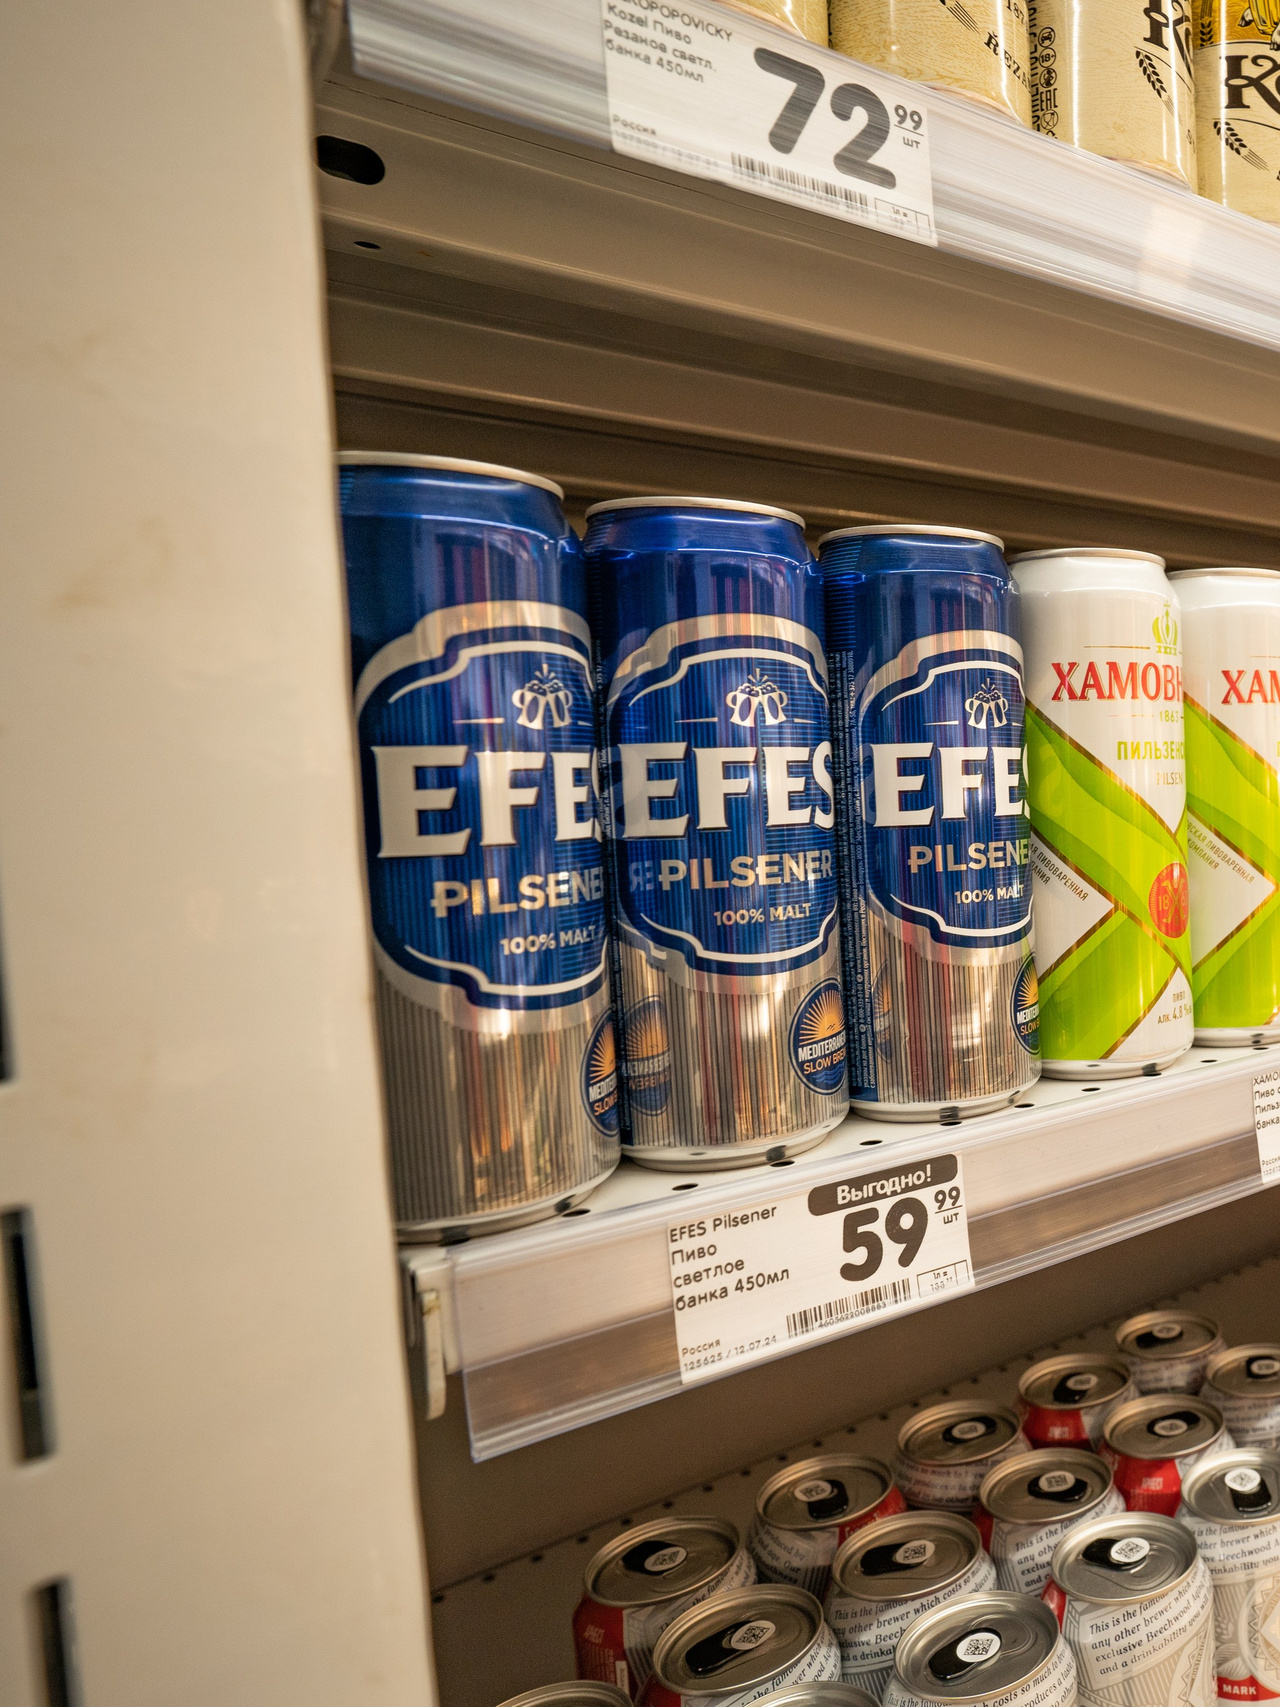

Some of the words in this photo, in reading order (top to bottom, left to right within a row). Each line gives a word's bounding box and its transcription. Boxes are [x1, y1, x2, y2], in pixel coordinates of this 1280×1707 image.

[604, 20, 667, 53] Резаное
[607, 2, 648, 28] Kozel
[653, 20, 691, 45] Пиво
[606, 38, 651, 65] банка
[656, 56, 704, 83] 450мл
[613, 114, 656, 136] Россия
[754, 47, 896, 190] 72
[894, 104, 923, 131] 99
[902, 136, 921, 150] шт
[618, 741, 835, 839] EFES
[870, 742, 1030, 828] EFE
[371, 745, 601, 858] EFE
[659, 849, 832, 891] PILSENER
[1037, 851, 1089, 901] ПИВОВАРЕННАЯ
[955, 889, 993, 904] 100%
[997, 885, 1024, 901] MALT
[714, 907, 765, 926] 100%
[770, 903, 811, 922] MALT
[501, 933, 557, 955] 100%
[560, 925, 596, 948] MALT
[803, 1057, 831, 1074] SLOW
[1255, 1087, 1275, 1100] Пиво
[1256, 1115, 1280, 1130] банка
[836, 1164, 932, 1205] Выгодно!
[934, 1185, 961, 1209] 99
[670, 1222, 707, 1243] EFES
[713, 1206, 777, 1232] Pilsener
[943, 1213, 960, 1225] шт
[840, 1197, 929, 1282] 59
[671, 1243, 717, 1266] Пиво
[673, 1258, 745, 1288] светлое
[676, 1286, 729, 1311] банка
[735, 1268, 790, 1293] 450мл
[682, 1339, 721, 1358] Россия
[684, 1353, 723, 1371] 125625
[734, 1335, 777, 1355] 12.07.24
[1015, 1540, 1033, 1552] This
[1036, 1534, 1044, 1544] is
[1045, 1527, 1059, 1539] the
[1205, 1527, 1217, 1536] the
[1220, 1535, 1250, 1549] brewer
[1253, 1524, 1277, 1540] which
[1017, 1554, 1035, 1565] any
[1262, 1556, 1280, 1567] you
[1025, 1576, 1042, 1587] and
[834, 1610, 848, 1620] This
[860, 1605, 872, 1616] the
[849, 1622, 873, 1635] other
[877, 1610, 911, 1629] brewer
[913, 1596, 941, 1616] which
[943, 1582, 962, 1600] costs
[1090, 1621, 1110, 1635] This
[1112, 1616, 1121, 1627] is
[1122, 1610, 1137, 1623] the
[1092, 1639, 1111, 1650] any
[1114, 1623, 1140, 1642] other
[1143, 1602, 1172, 1627] brewer
[1096, 1639, 1143, 1662] exclusive
[1146, 1599, 1192, 1643] Beechwood
[1100, 1662, 1119, 1675] and
[1131, 1625, 1187, 1664] drinkability
[1021, 1684, 1031, 1694] so
[1033, 1667, 1052, 1688] much
[1223, 1684, 1257, 1696] MARK
